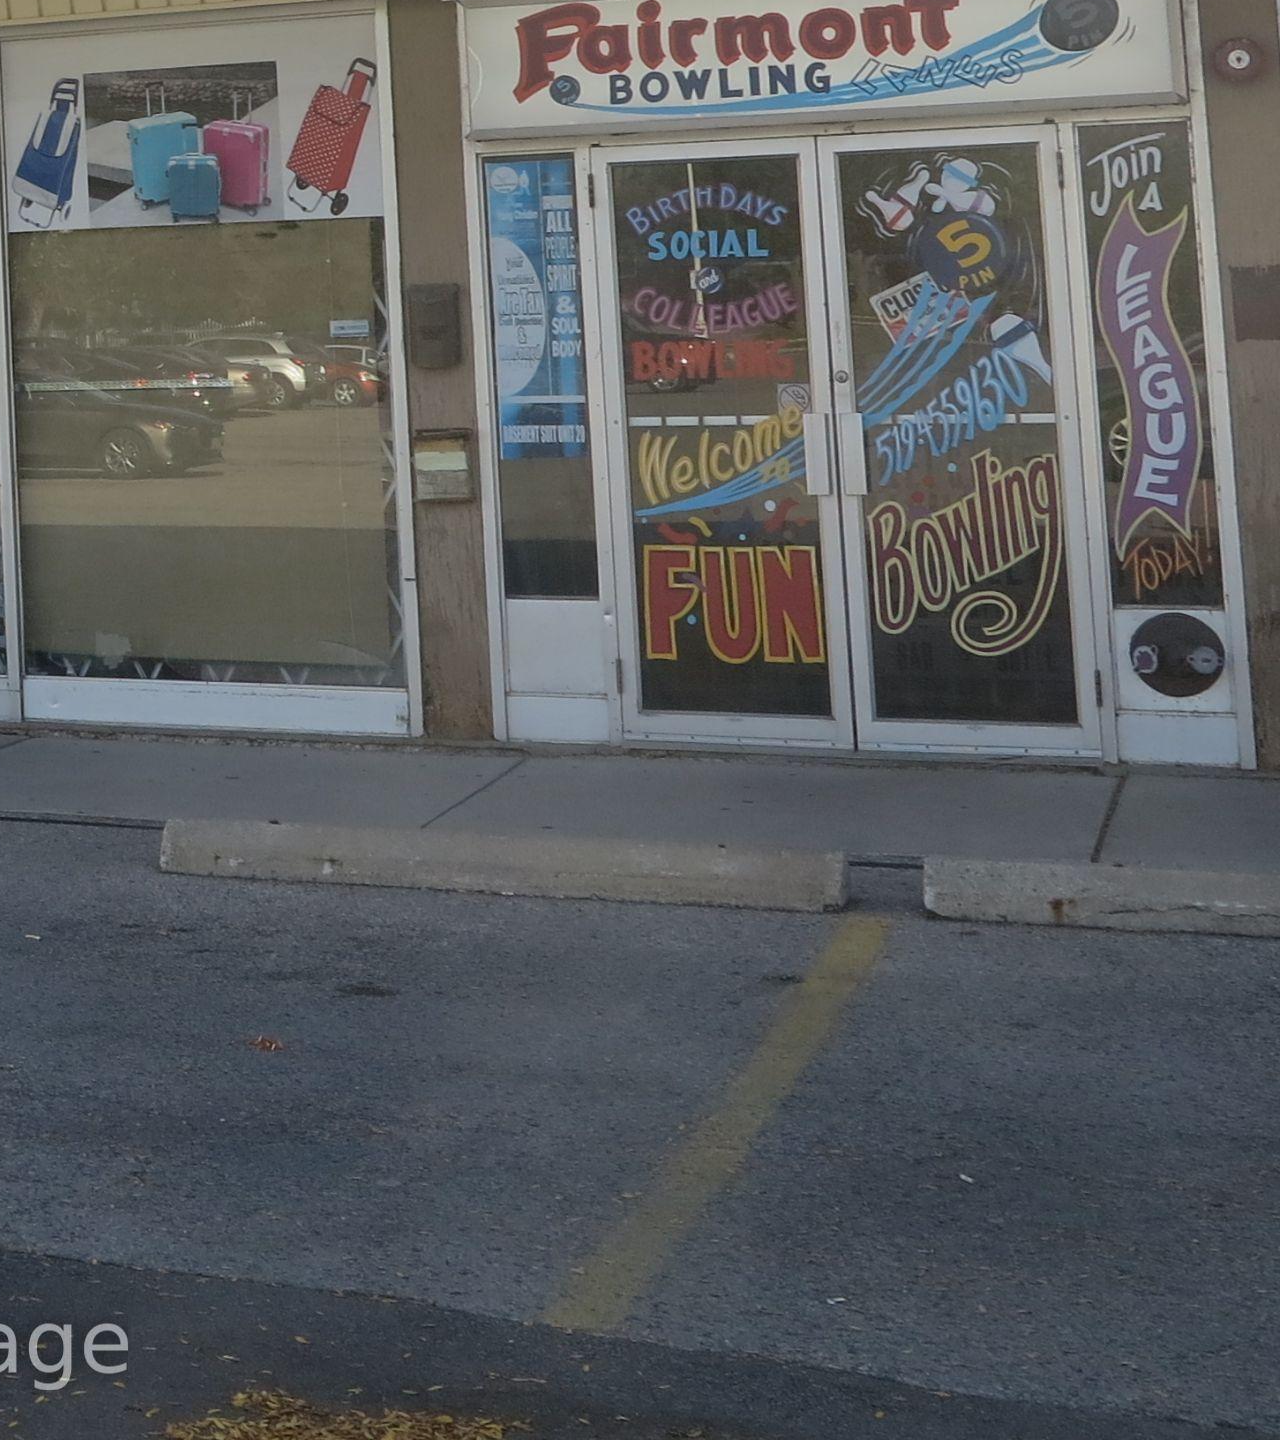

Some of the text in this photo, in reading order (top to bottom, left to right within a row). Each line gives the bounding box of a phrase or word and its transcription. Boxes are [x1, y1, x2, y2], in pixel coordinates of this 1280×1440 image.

[609, 49, 1023, 105] BOWLING LANES
[1086, 132, 1166, 217] Join
[625, 182, 789, 235] BIRTHDAYS
[1138, 182, 1162, 212] A
[546, 211, 573, 233] ALL
[545, 236, 576, 259] PEOPLE
[648, 228, 770, 260] SOCIAL
[936, 220, 992, 268] 5
[547, 264, 576, 292] SPIRIT
[699, 269, 720, 289] and
[958, 266, 995, 289] PIN
[556, 295, 576, 313] &
[633, 282, 800, 336] COLLEAGUE
[880, 278, 939, 319] CLO
[551, 317, 581, 335] SOUL
[551, 340, 582, 358] BODY
[631, 339, 796, 381] BOWLING
[1116, 244, 1186, 506] LEAGUE
[638, 404, 804, 506] Welcome
[866, 448, 1062, 656] Bowling
[643, 544, 826, 664] FUN
